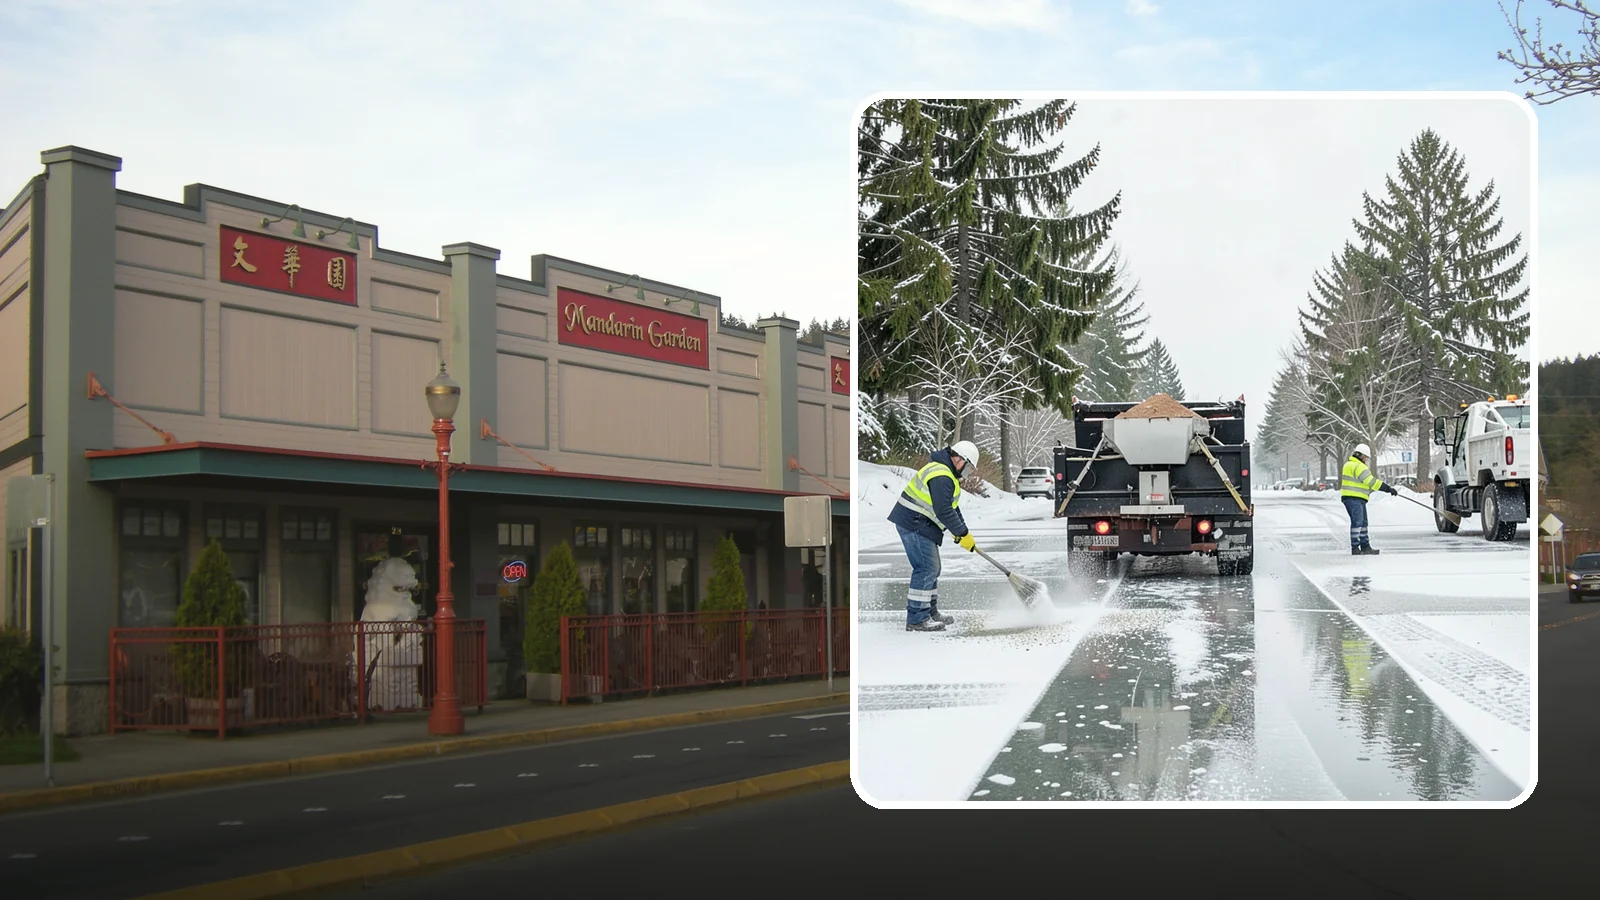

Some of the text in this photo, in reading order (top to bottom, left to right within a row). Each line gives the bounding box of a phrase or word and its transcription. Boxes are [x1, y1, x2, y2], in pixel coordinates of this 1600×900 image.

[231, 236, 346, 290] 文華園
[564, 302, 702, 352] Mandarin Garden
[503, 565, 527, 578] OPEN
